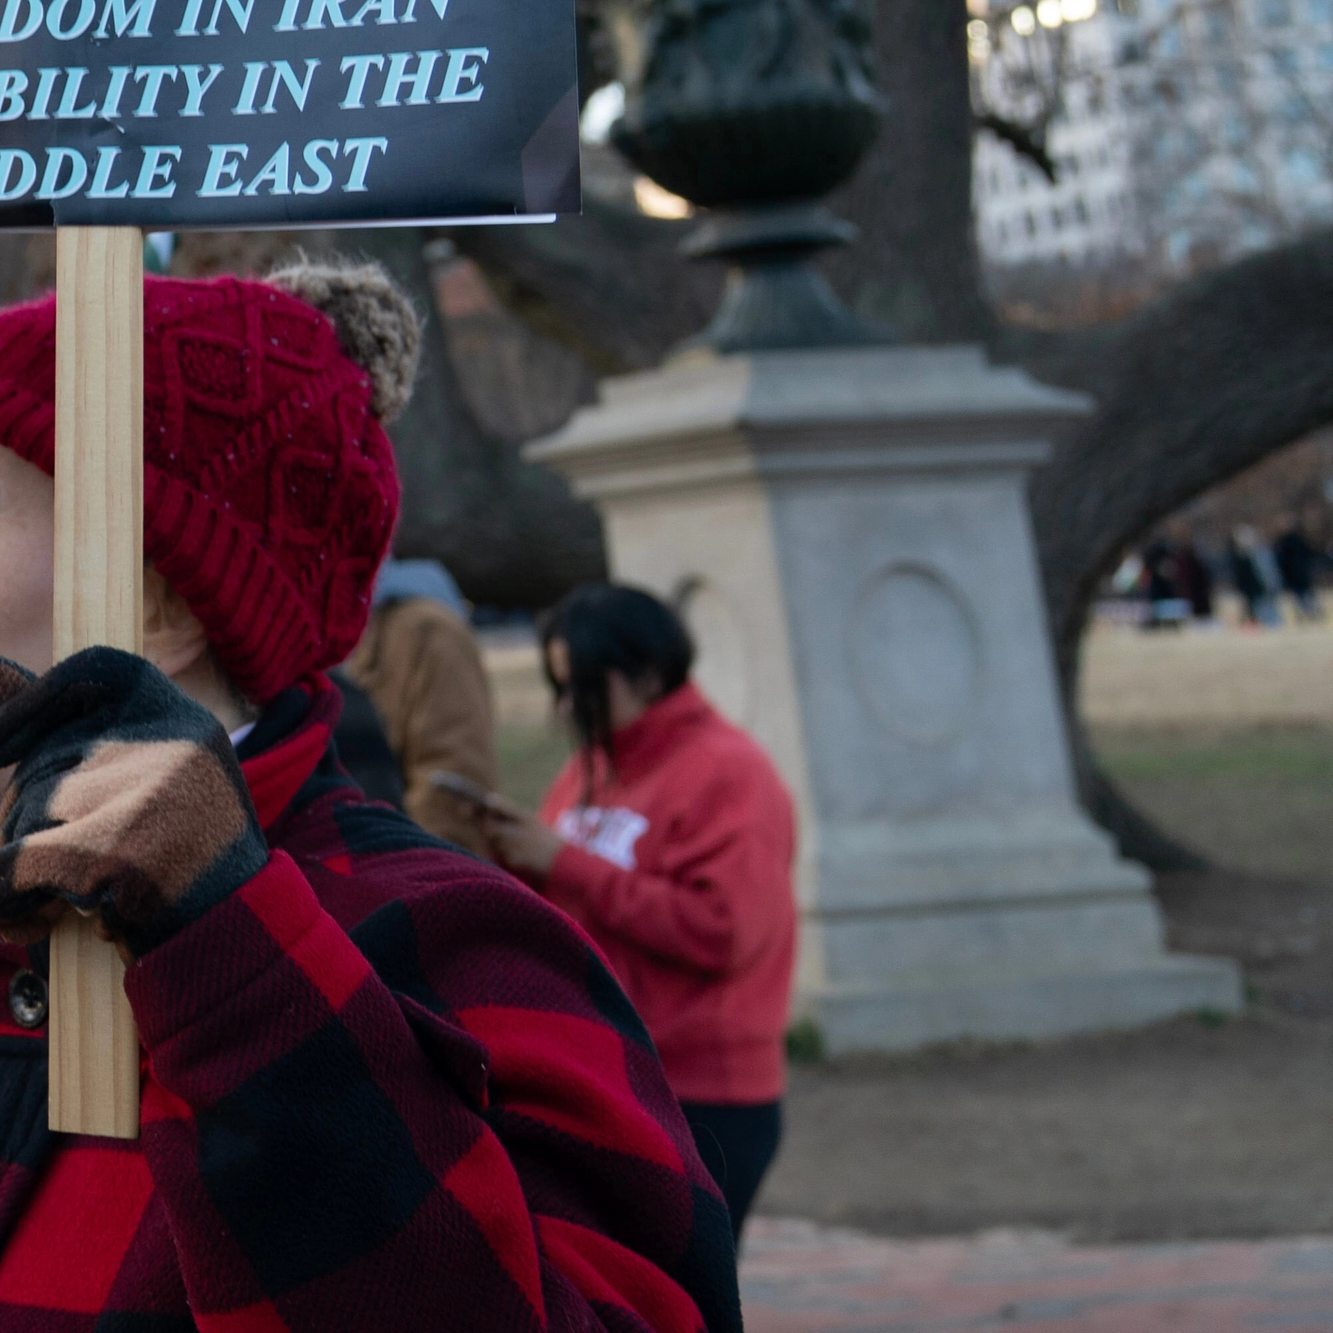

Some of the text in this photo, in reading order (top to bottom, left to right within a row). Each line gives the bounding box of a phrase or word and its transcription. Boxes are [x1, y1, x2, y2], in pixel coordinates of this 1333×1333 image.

[231, 59, 321, 115] IN
[338, 47, 490, 110] THE
[196, 136, 389, 198] EAST
